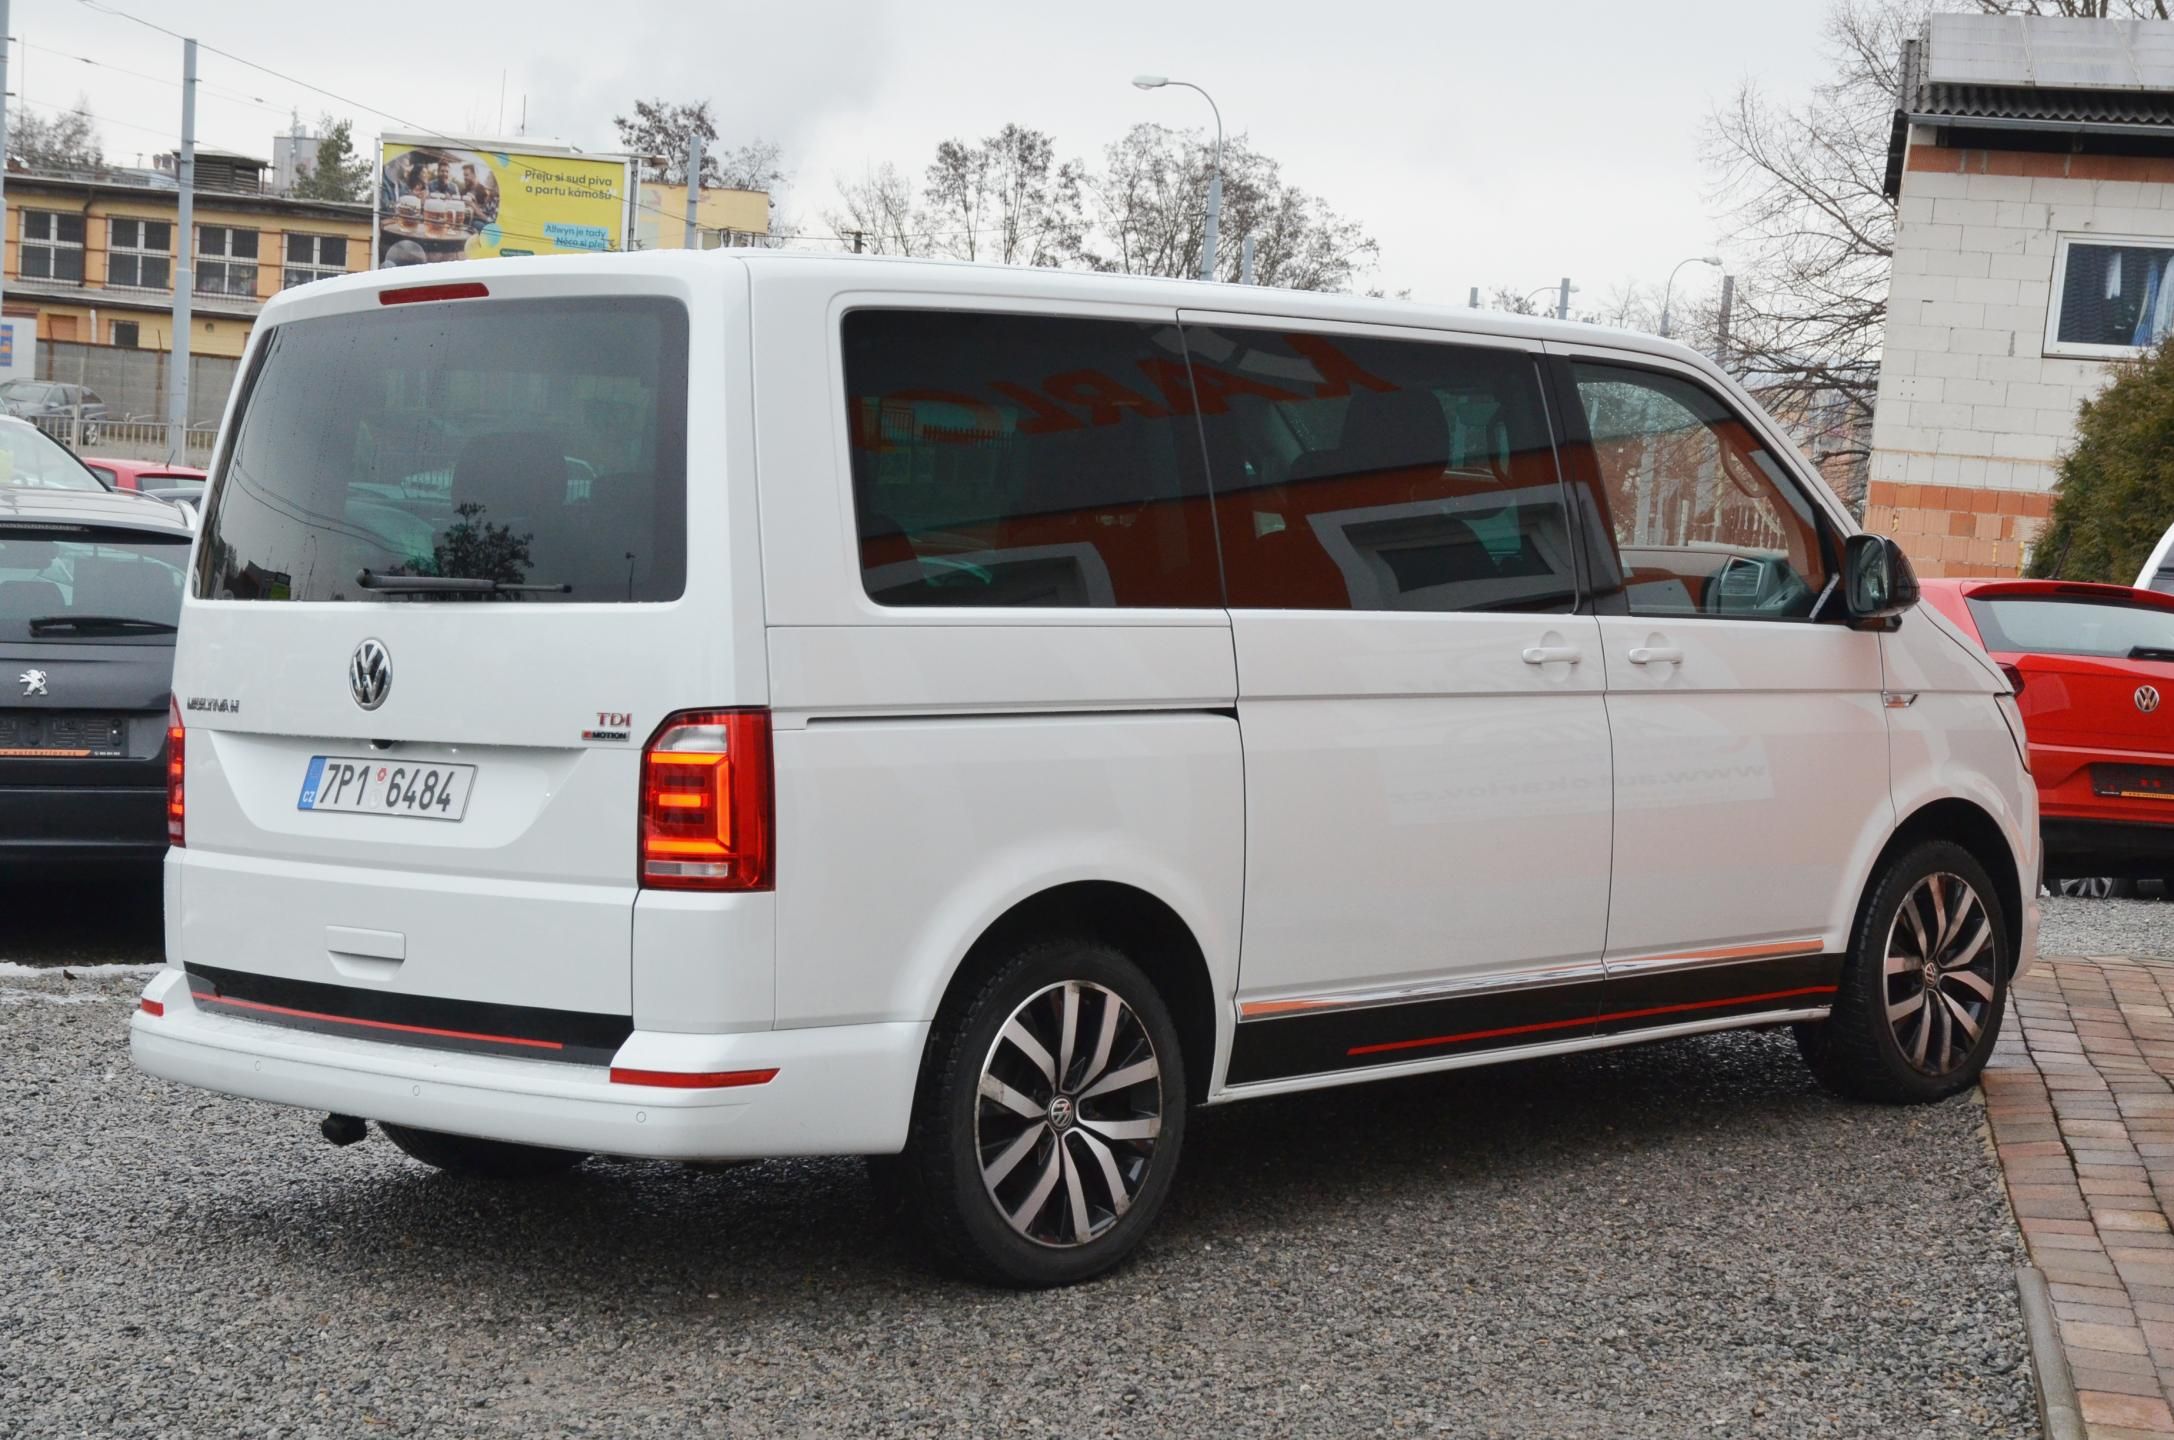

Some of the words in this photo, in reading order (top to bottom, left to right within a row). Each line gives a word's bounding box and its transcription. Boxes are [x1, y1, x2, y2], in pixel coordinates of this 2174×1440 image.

[554, 172, 564, 182] si
[566, 174, 586, 185] sud
[588, 175, 612, 189] piva
[525, 185, 533, 193] a
[535, 185, 566, 197] partu
[545, 223, 575, 236] Allwyn
[576, 226, 584, 238] je
[586, 228, 606, 239] tady
[596, 712, 632, 727] TDI
[319, 763, 371, 806] 7P1
[385, 767, 455, 812] 6484
[302, 791, 316, 803] CZ
